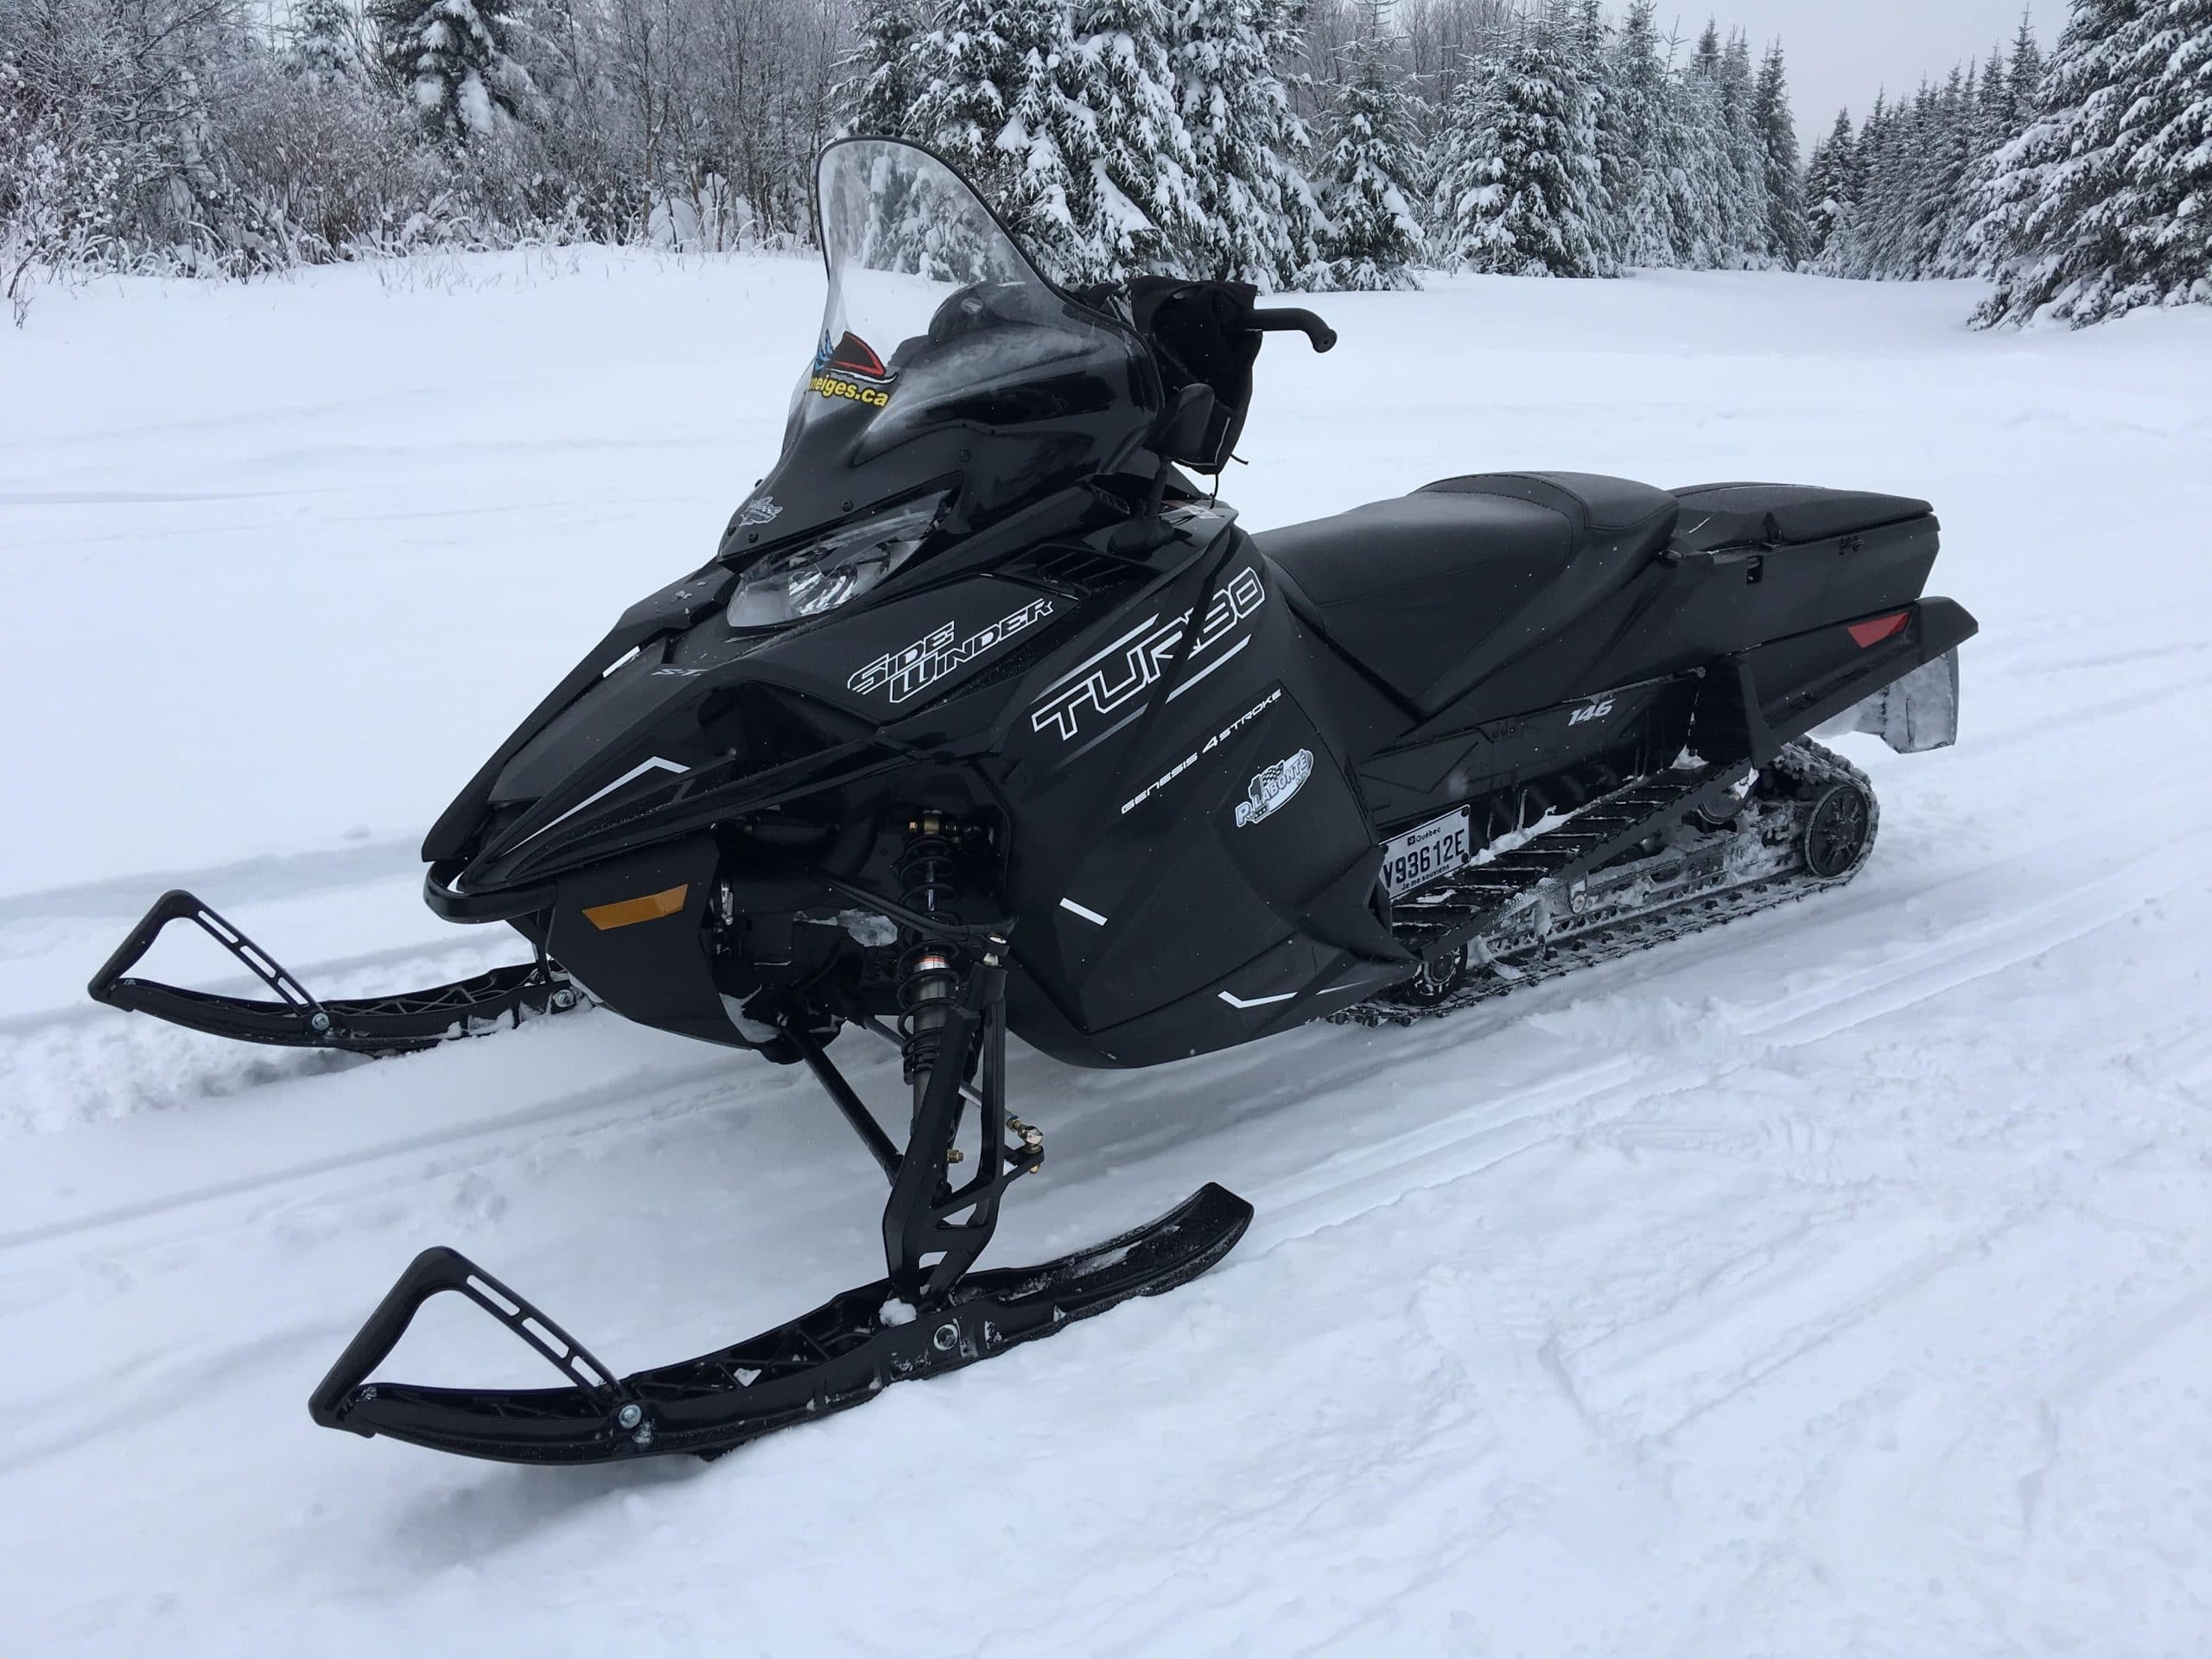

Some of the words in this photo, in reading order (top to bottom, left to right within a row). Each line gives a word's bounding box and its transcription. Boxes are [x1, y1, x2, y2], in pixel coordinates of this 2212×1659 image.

[848, 620, 955, 695] SIDE
[889, 599, 1054, 703] WINDER
[1567, 698, 1617, 727] 146
[1383, 829, 1465, 888] V93612E
